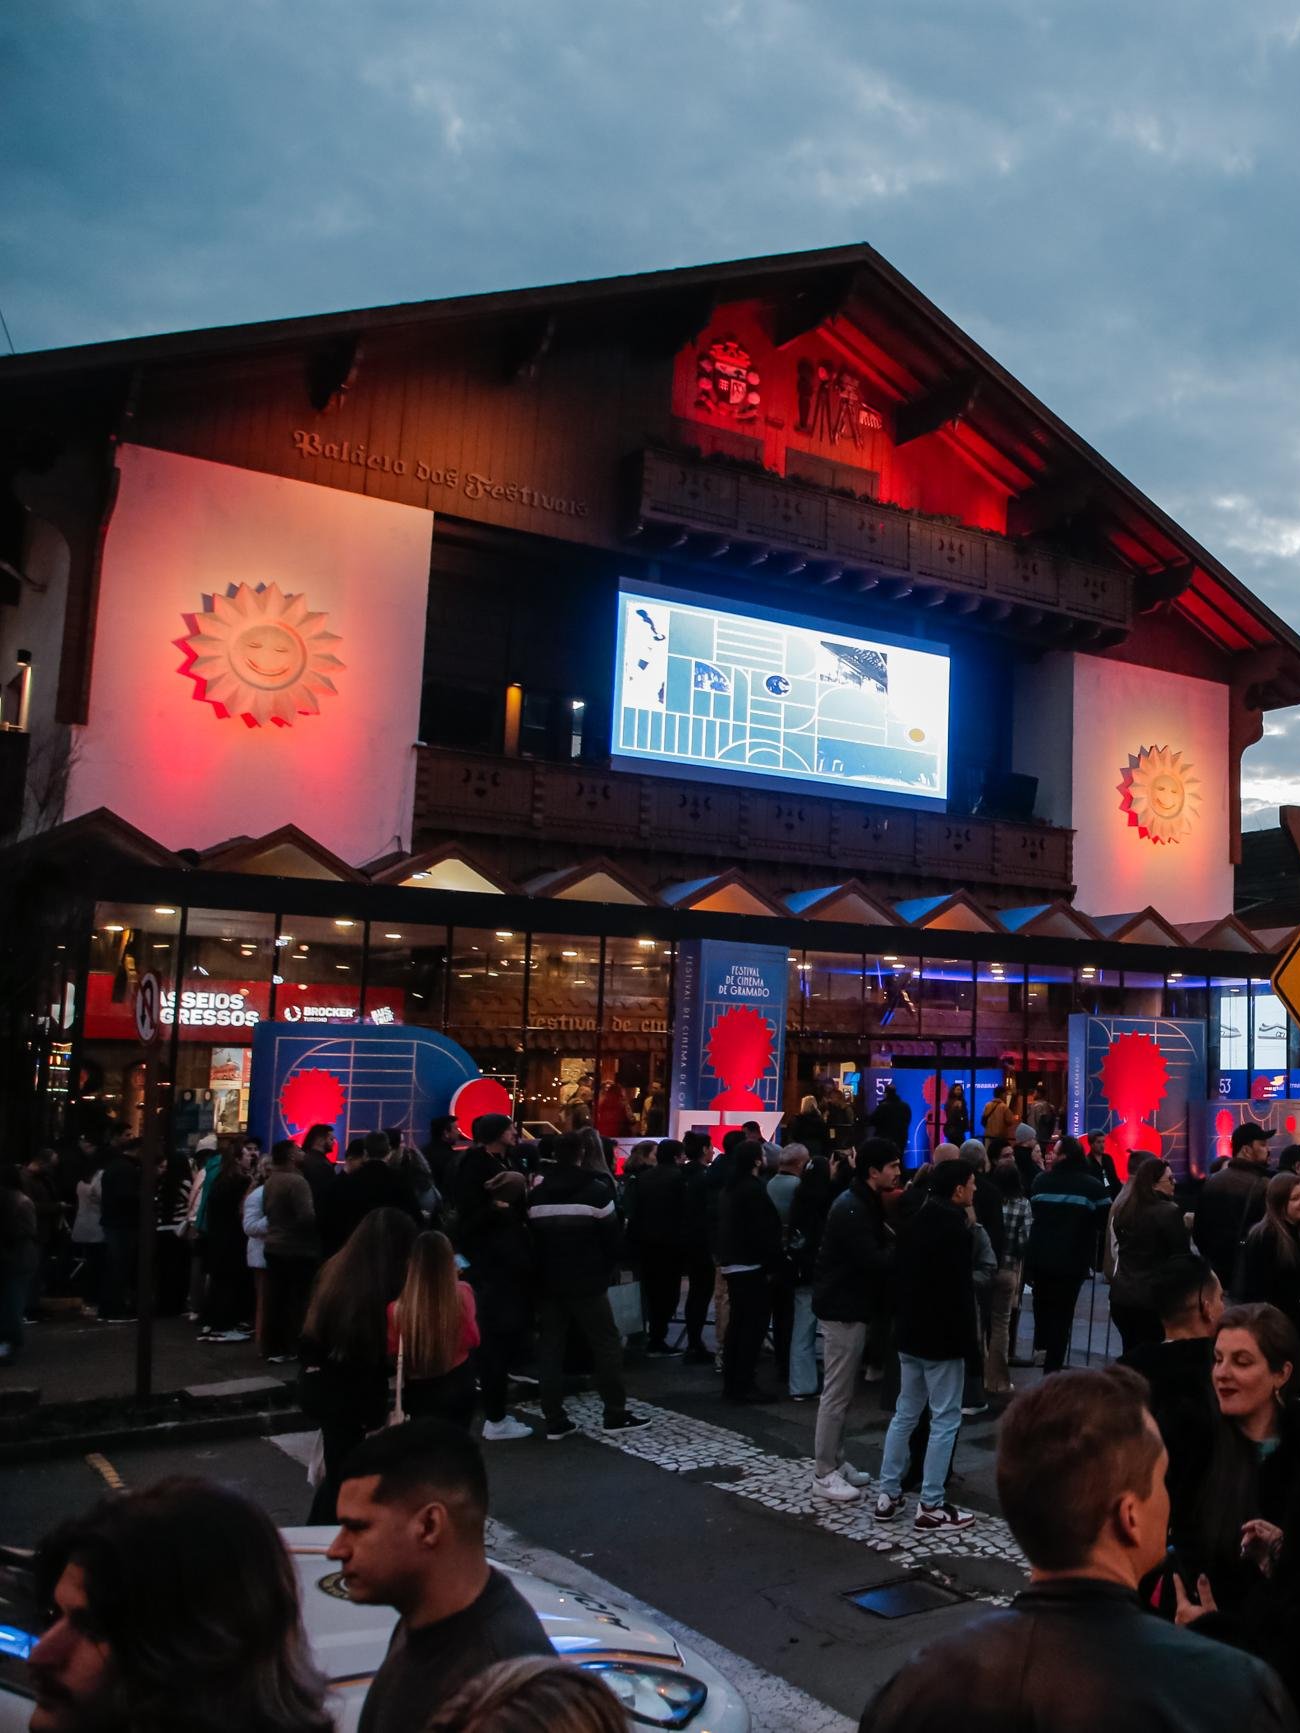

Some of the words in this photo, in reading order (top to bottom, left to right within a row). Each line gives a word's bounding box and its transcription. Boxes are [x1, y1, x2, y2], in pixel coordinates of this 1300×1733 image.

[293, 430, 406, 475] Palácio
[416, 460, 458, 488] dos
[464, 472, 589, 517] Festivais
[683, 955, 693, 1001] FESTIVAL
[731, 965, 760, 976] FESTIVAL
[725, 975, 735, 986] DE
[736, 976, 765, 987] CINEMA
[718, 985, 728, 995] DE
[730, 985, 770, 998] GRAMADO
[159, 1008, 260, 1027] GRESSOS
[303, 1006, 353, 1018] BROCKER
[612, 1013, 631, 1033] de
[679, 1025, 689, 1067] CINEMA
[1219, 1078, 1232, 1094] 53
